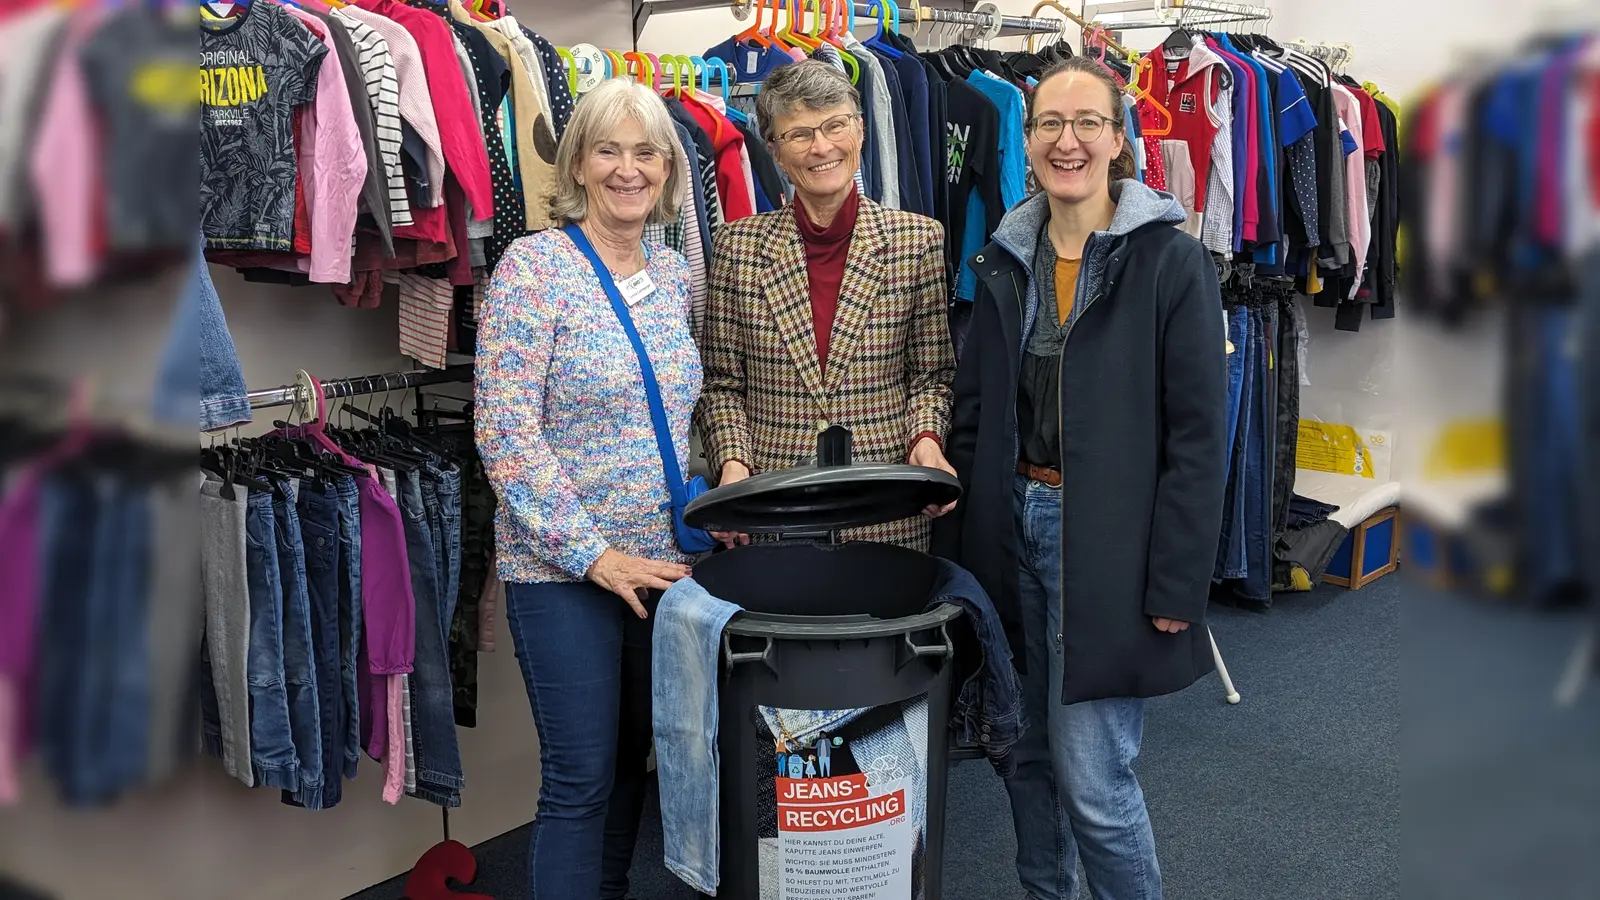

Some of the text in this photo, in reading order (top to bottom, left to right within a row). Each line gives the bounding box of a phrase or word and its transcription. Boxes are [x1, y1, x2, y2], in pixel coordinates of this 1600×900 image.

[783, 780, 860, 799] JEANS-
[786, 797, 899, 827] RECYCLING
[888, 815, 906, 827] .ORG
[846, 836, 867, 845] DEINE
[844, 842, 884, 854] EINWERFEN.
[785, 858, 817, 866] WICHTIG:
[855, 850, 897, 863] MINDESTENS
[852, 860, 891, 872] ENTHALTEN.
[851, 871, 890, 883] TEXTILMÜLL
[786, 887, 830, 895] REDUZIEREN
[850, 880, 888, 893] WERTVOLLE
